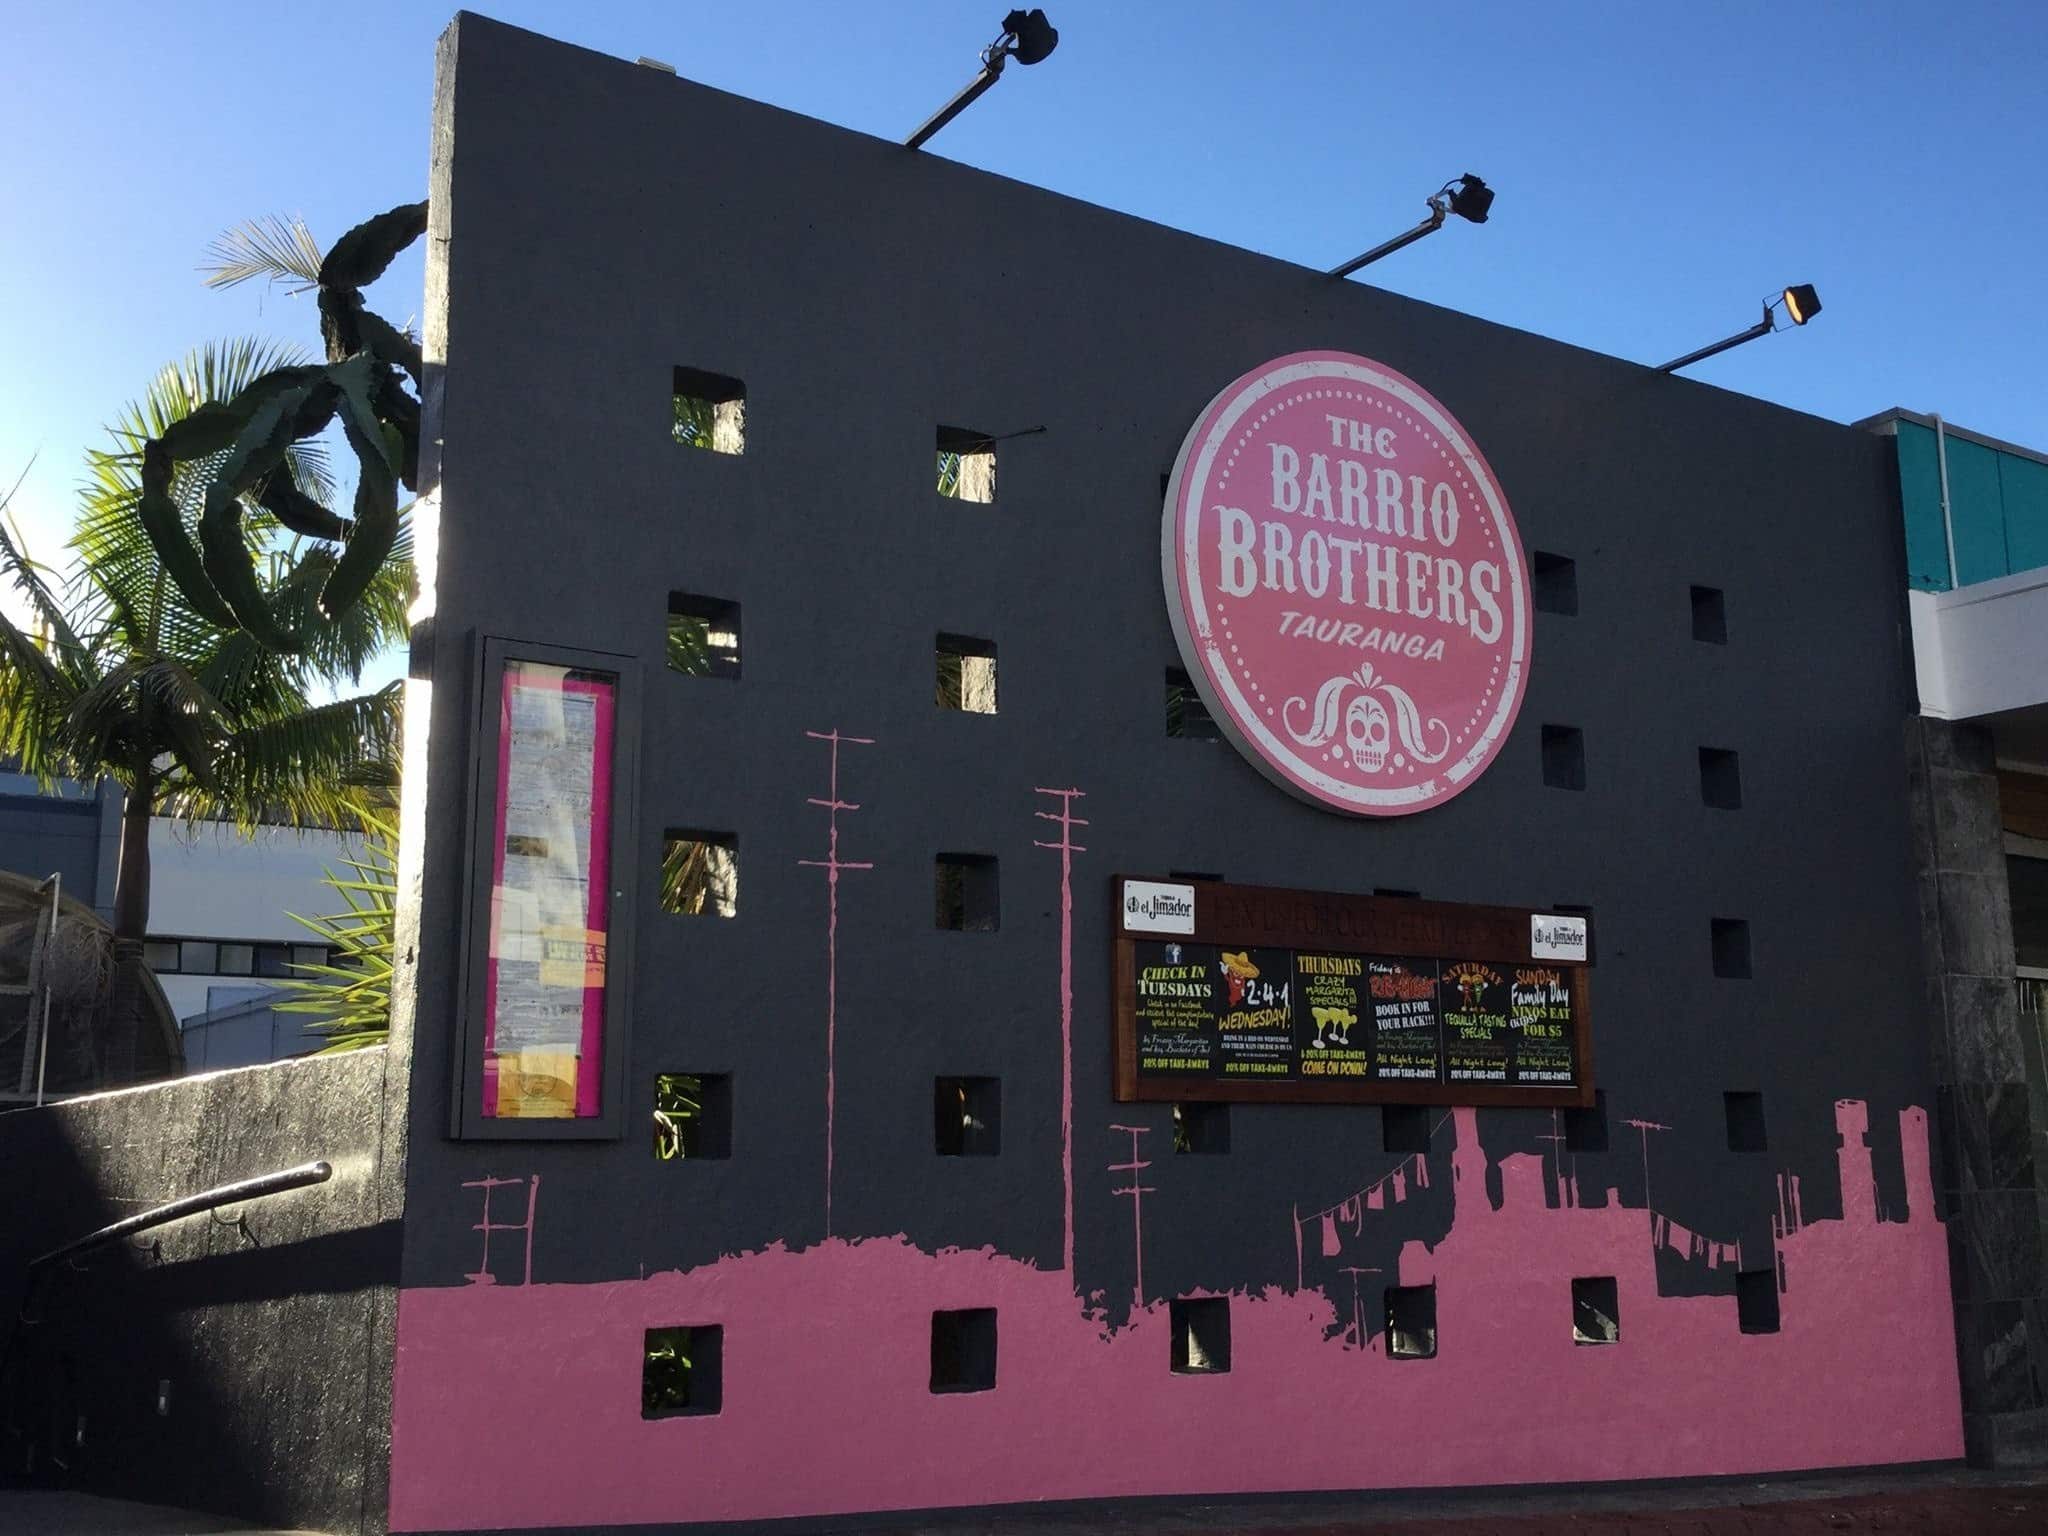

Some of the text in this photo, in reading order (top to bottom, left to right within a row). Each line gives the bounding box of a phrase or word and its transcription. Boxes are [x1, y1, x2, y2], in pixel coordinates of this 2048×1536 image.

[1326, 414, 1398, 460] THE
[1266, 442, 1461, 548] BARRIO
[1212, 505, 1502, 644] BROTHERS
[1280, 611, 1446, 662] TAURANGA
[1141, 895, 1192, 920] el Jimador
[1143, 965, 1207, 983] CHECK IN
[1297, 955, 1361, 976] THURSDAYS
[1314, 975, 1345, 988] CRAZY
[1515, 969, 1560, 987] SUNDAY
[1137, 979, 1212, 997] TUESDAYS
[1305, 986, 1357, 997] MARGARITA
[1511, 980, 1569, 1009] Family Day
[1375, 1000, 1430, 1017] BOOK IN FOR
[1550, 1007, 1571, 1020] EAT
[1218, 1005, 1291, 1031] WEDNESDAY!
[1376, 1014, 1435, 1031] YOUR RACK!!!
[1524, 1024, 1562, 1037] FOR $5
[1302, 1060, 1367, 1076] COME ON DOWN!
